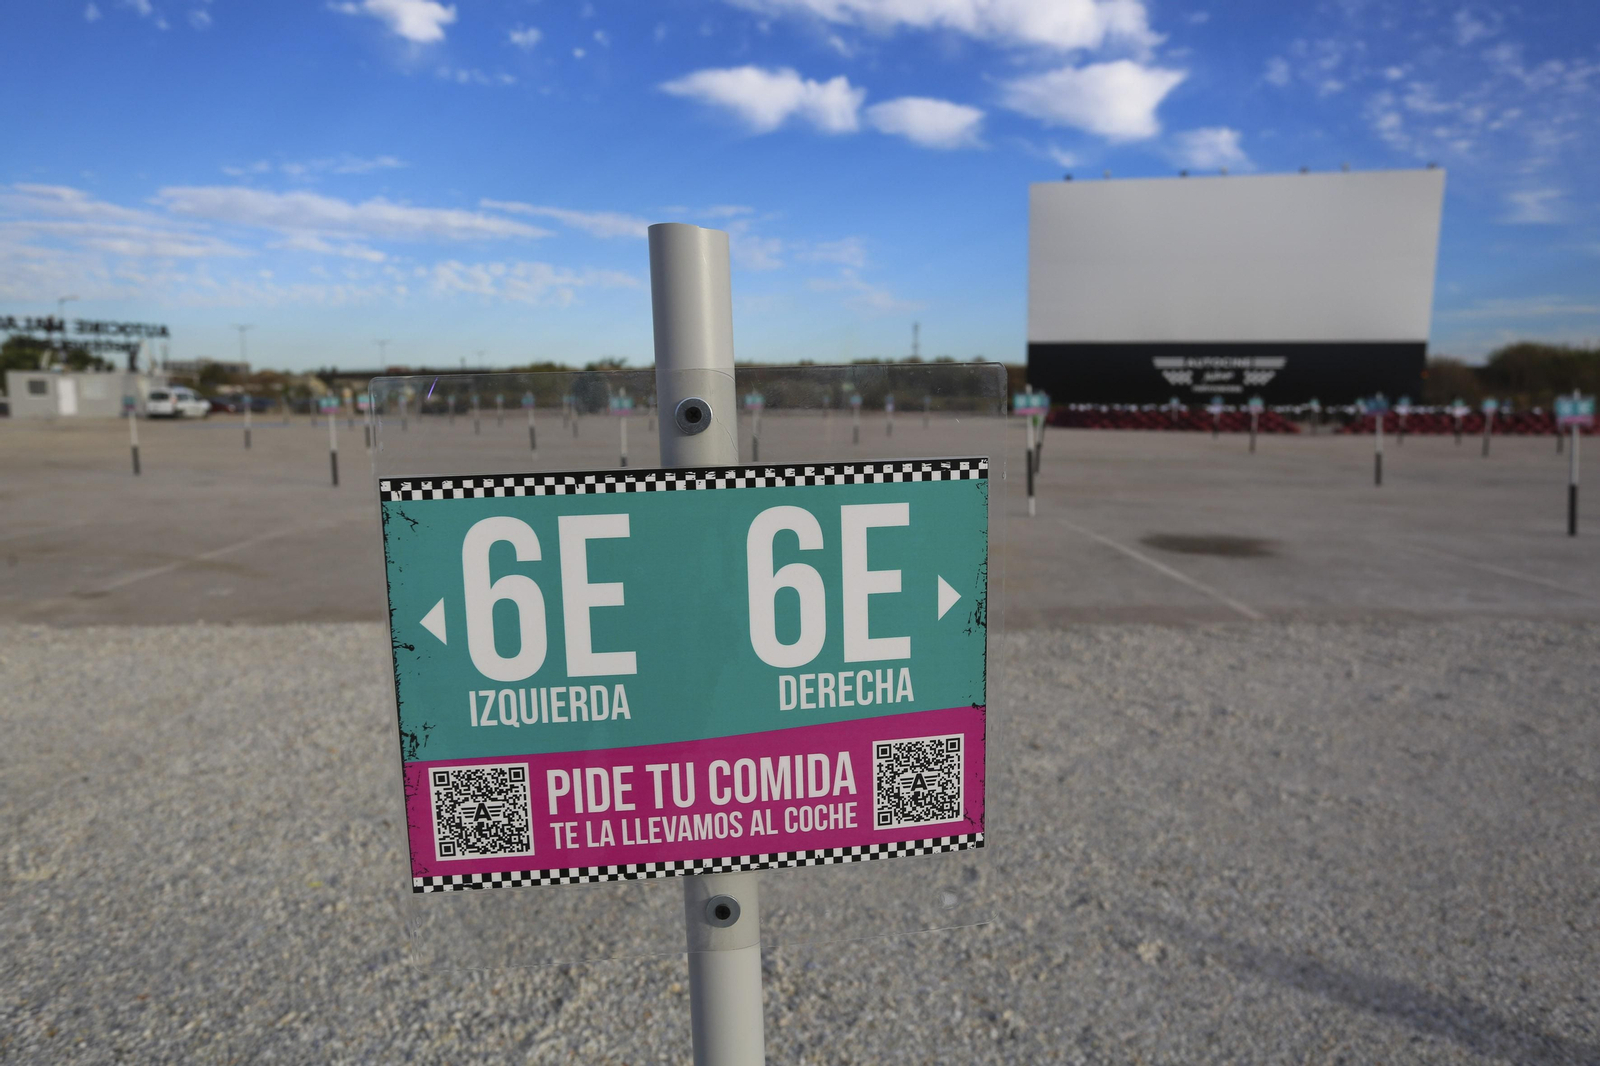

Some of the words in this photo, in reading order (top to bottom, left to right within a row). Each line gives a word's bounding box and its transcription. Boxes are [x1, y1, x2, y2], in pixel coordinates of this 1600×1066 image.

[462, 513, 637, 682] 6E
[746, 503, 911, 668] 6E
[469, 685, 631, 728] IZQUIERDA
[779, 668, 915, 711] DERECHA
[546, 765, 636, 815] PIDE
[646, 762, 696, 809] TU
[708, 751, 857, 806] COMIDA
[549, 821, 580, 849] TE
[586, 819, 616, 848] LA
[621, 811, 744, 845] LLEVAMOS
[750, 807, 779, 836] AL
[784, 802, 858, 833] COCHE
